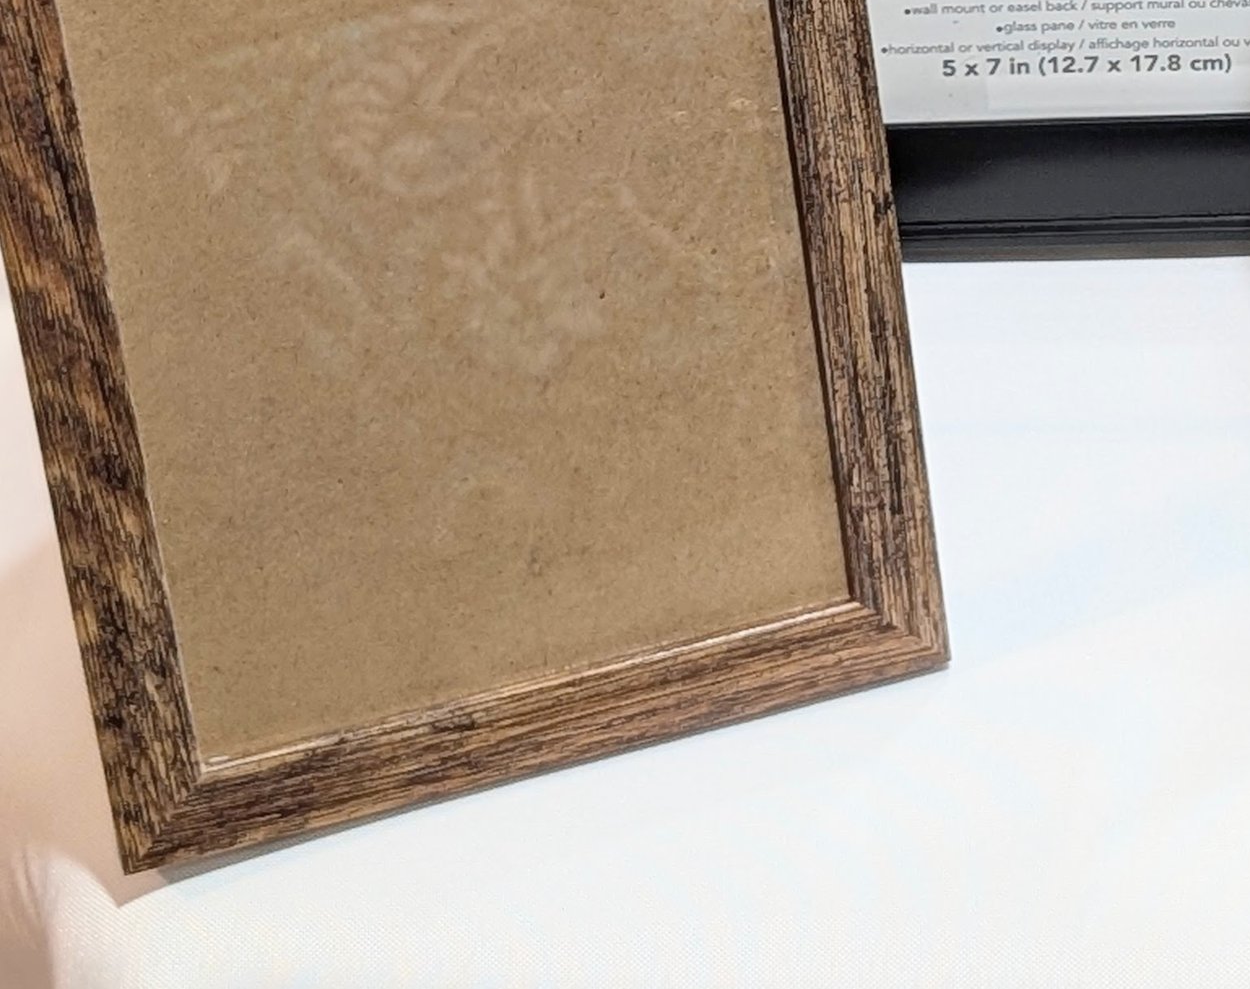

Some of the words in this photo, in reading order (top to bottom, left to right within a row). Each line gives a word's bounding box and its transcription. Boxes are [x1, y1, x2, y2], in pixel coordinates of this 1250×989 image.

[941, 1, 985, 15] mount
[989, 2, 1003, 13] or
[1007, 0, 1042, 13] easel
[1045, 0, 1078, 12] back
[1091, 0, 1143, 13] support
[1188, 0, 1205, 9] ou
[1041, 21, 1074, 34] pane
[1088, 19, 1117, 30] vitre
[1121, 20, 1138, 30] en
[1141, 19, 1176, 29] verre
[957, 43, 972, 54] or
[975, 40, 1024, 53] vertical
[1027, 39, 1075, 54] display
[1088, 37, 1149, 51] affichage
[1153, 35, 1218, 48] horizontal
[1222, 37, 1240, 47] ou
[942, 59, 956, 77] 5
[964, 62, 979, 76] x
[986, 58, 1002, 75] 7
[1009, 57, 1031, 75] in
[1038, 56, 1099, 76] (12.7
[1107, 59, 1122, 73] x
[1130, 54, 1182, 72] 17.8
[1190, 53, 1232, 73] cm)
